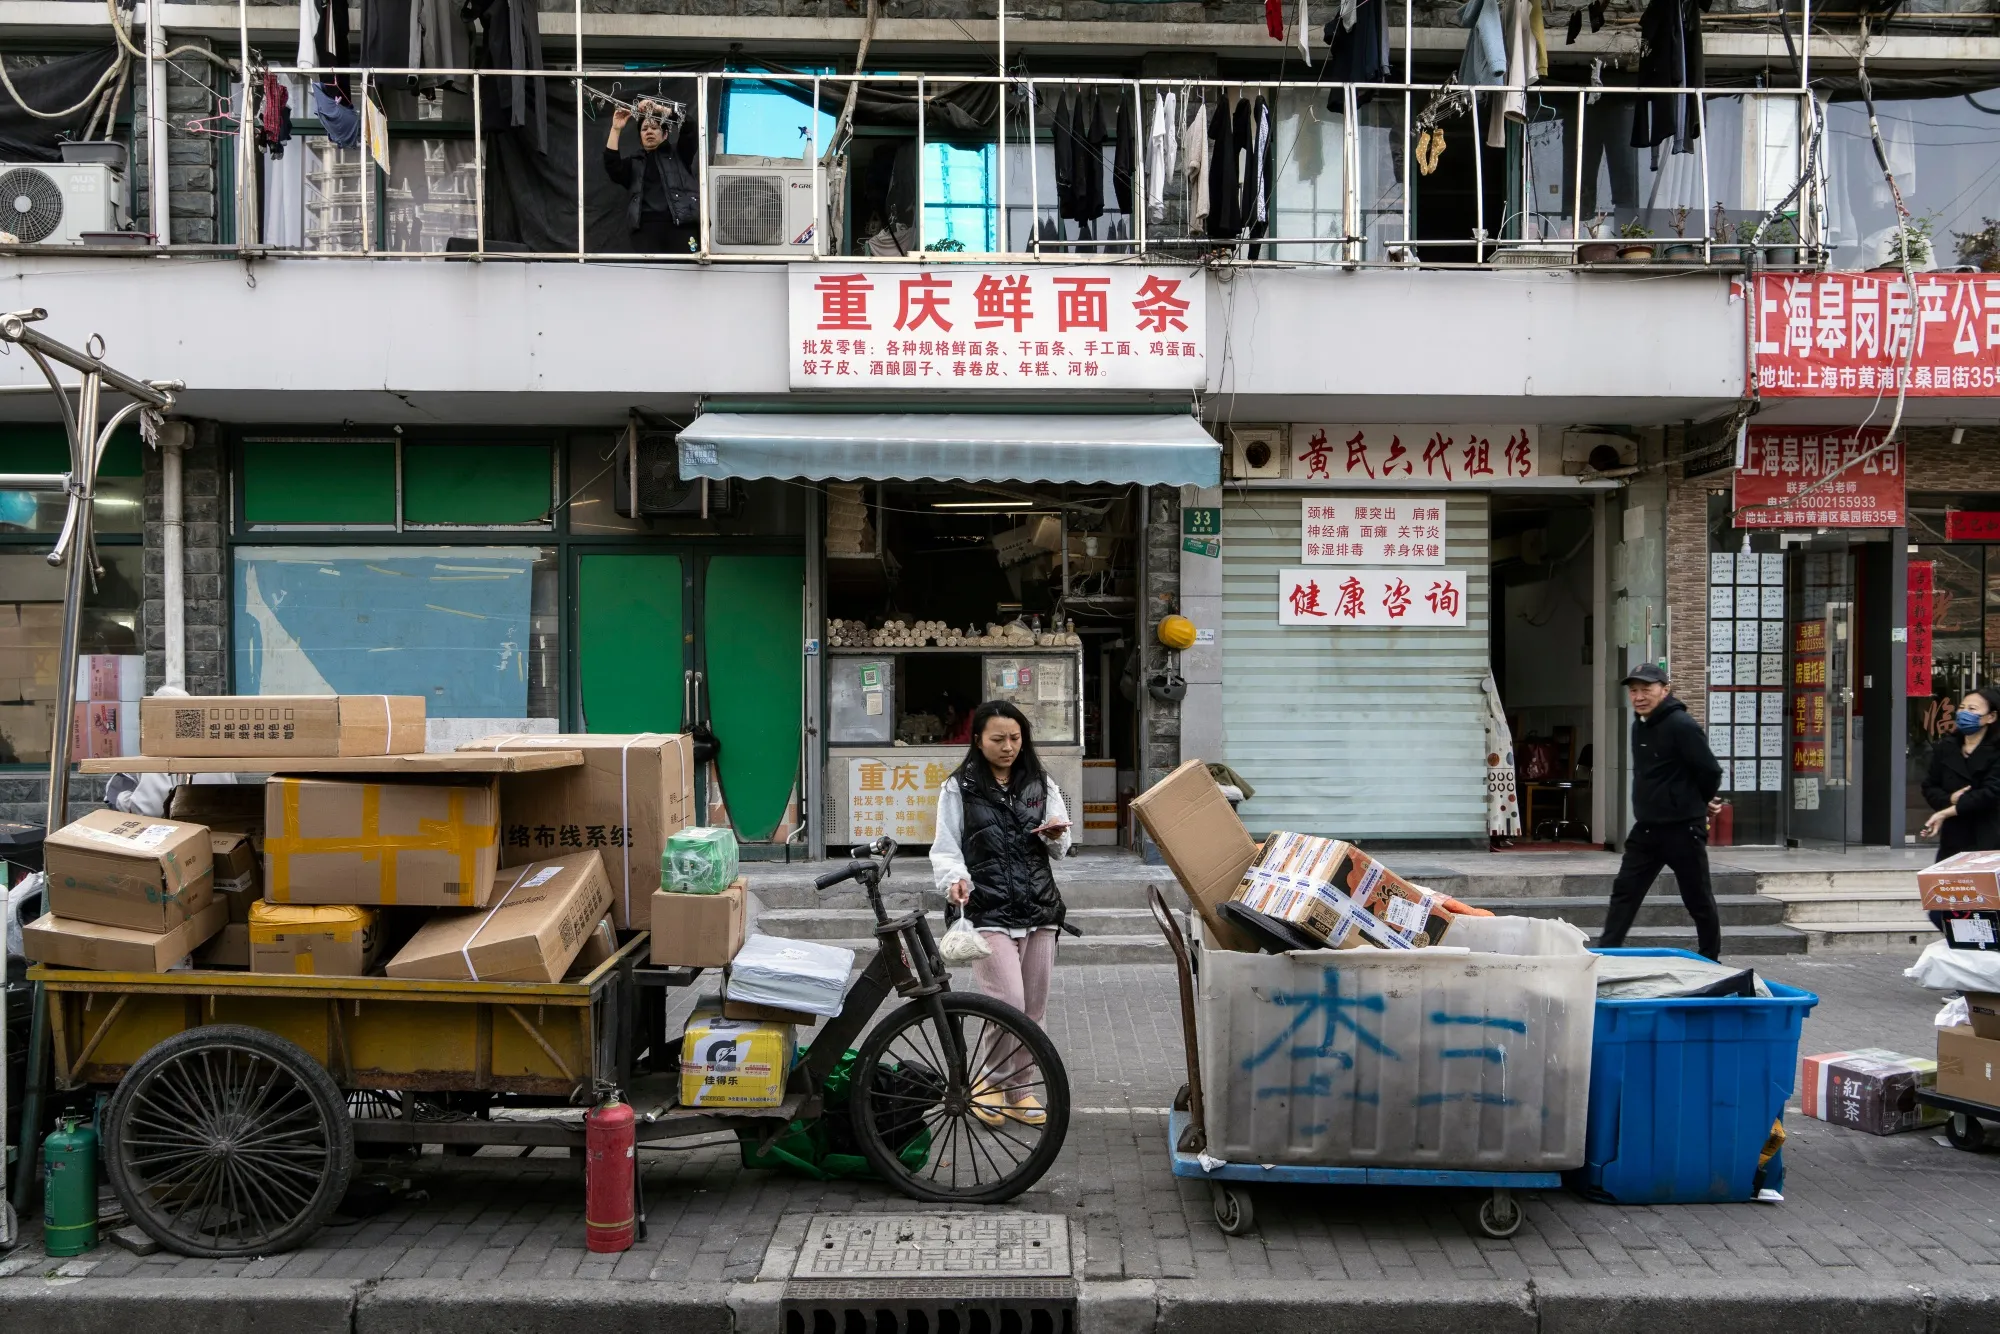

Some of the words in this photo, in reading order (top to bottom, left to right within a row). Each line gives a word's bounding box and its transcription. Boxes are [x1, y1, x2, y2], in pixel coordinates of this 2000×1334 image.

[70, 175, 96, 184] AUX
[814, 273, 1190, 333] 重庆鲜面条
[1298, 429, 1532, 481] 黄氏六代祖传
[1193, 511, 1211, 525] 33
[1308, 506, 1335, 519] 颈椎
[1354, 507, 1396, 520] 腰突出
[1412, 507, 1439, 520] 肩痛
[1307, 525, 1349, 538] 神经痛
[1360, 525, 1388, 538] 面瘫
[1398, 525, 1439, 538] 关节炎
[1307, 543, 1364, 556] 除湿排毒
[1383, 544, 1439, 557] 养身保健
[1288, 576, 1460, 620] 健康咨询
[501, 824, 633, 848] 络布线系统
[705, 1076, 738, 1086] 佳得乐
[1843, 1077, 1862, 1121] 紅茶
